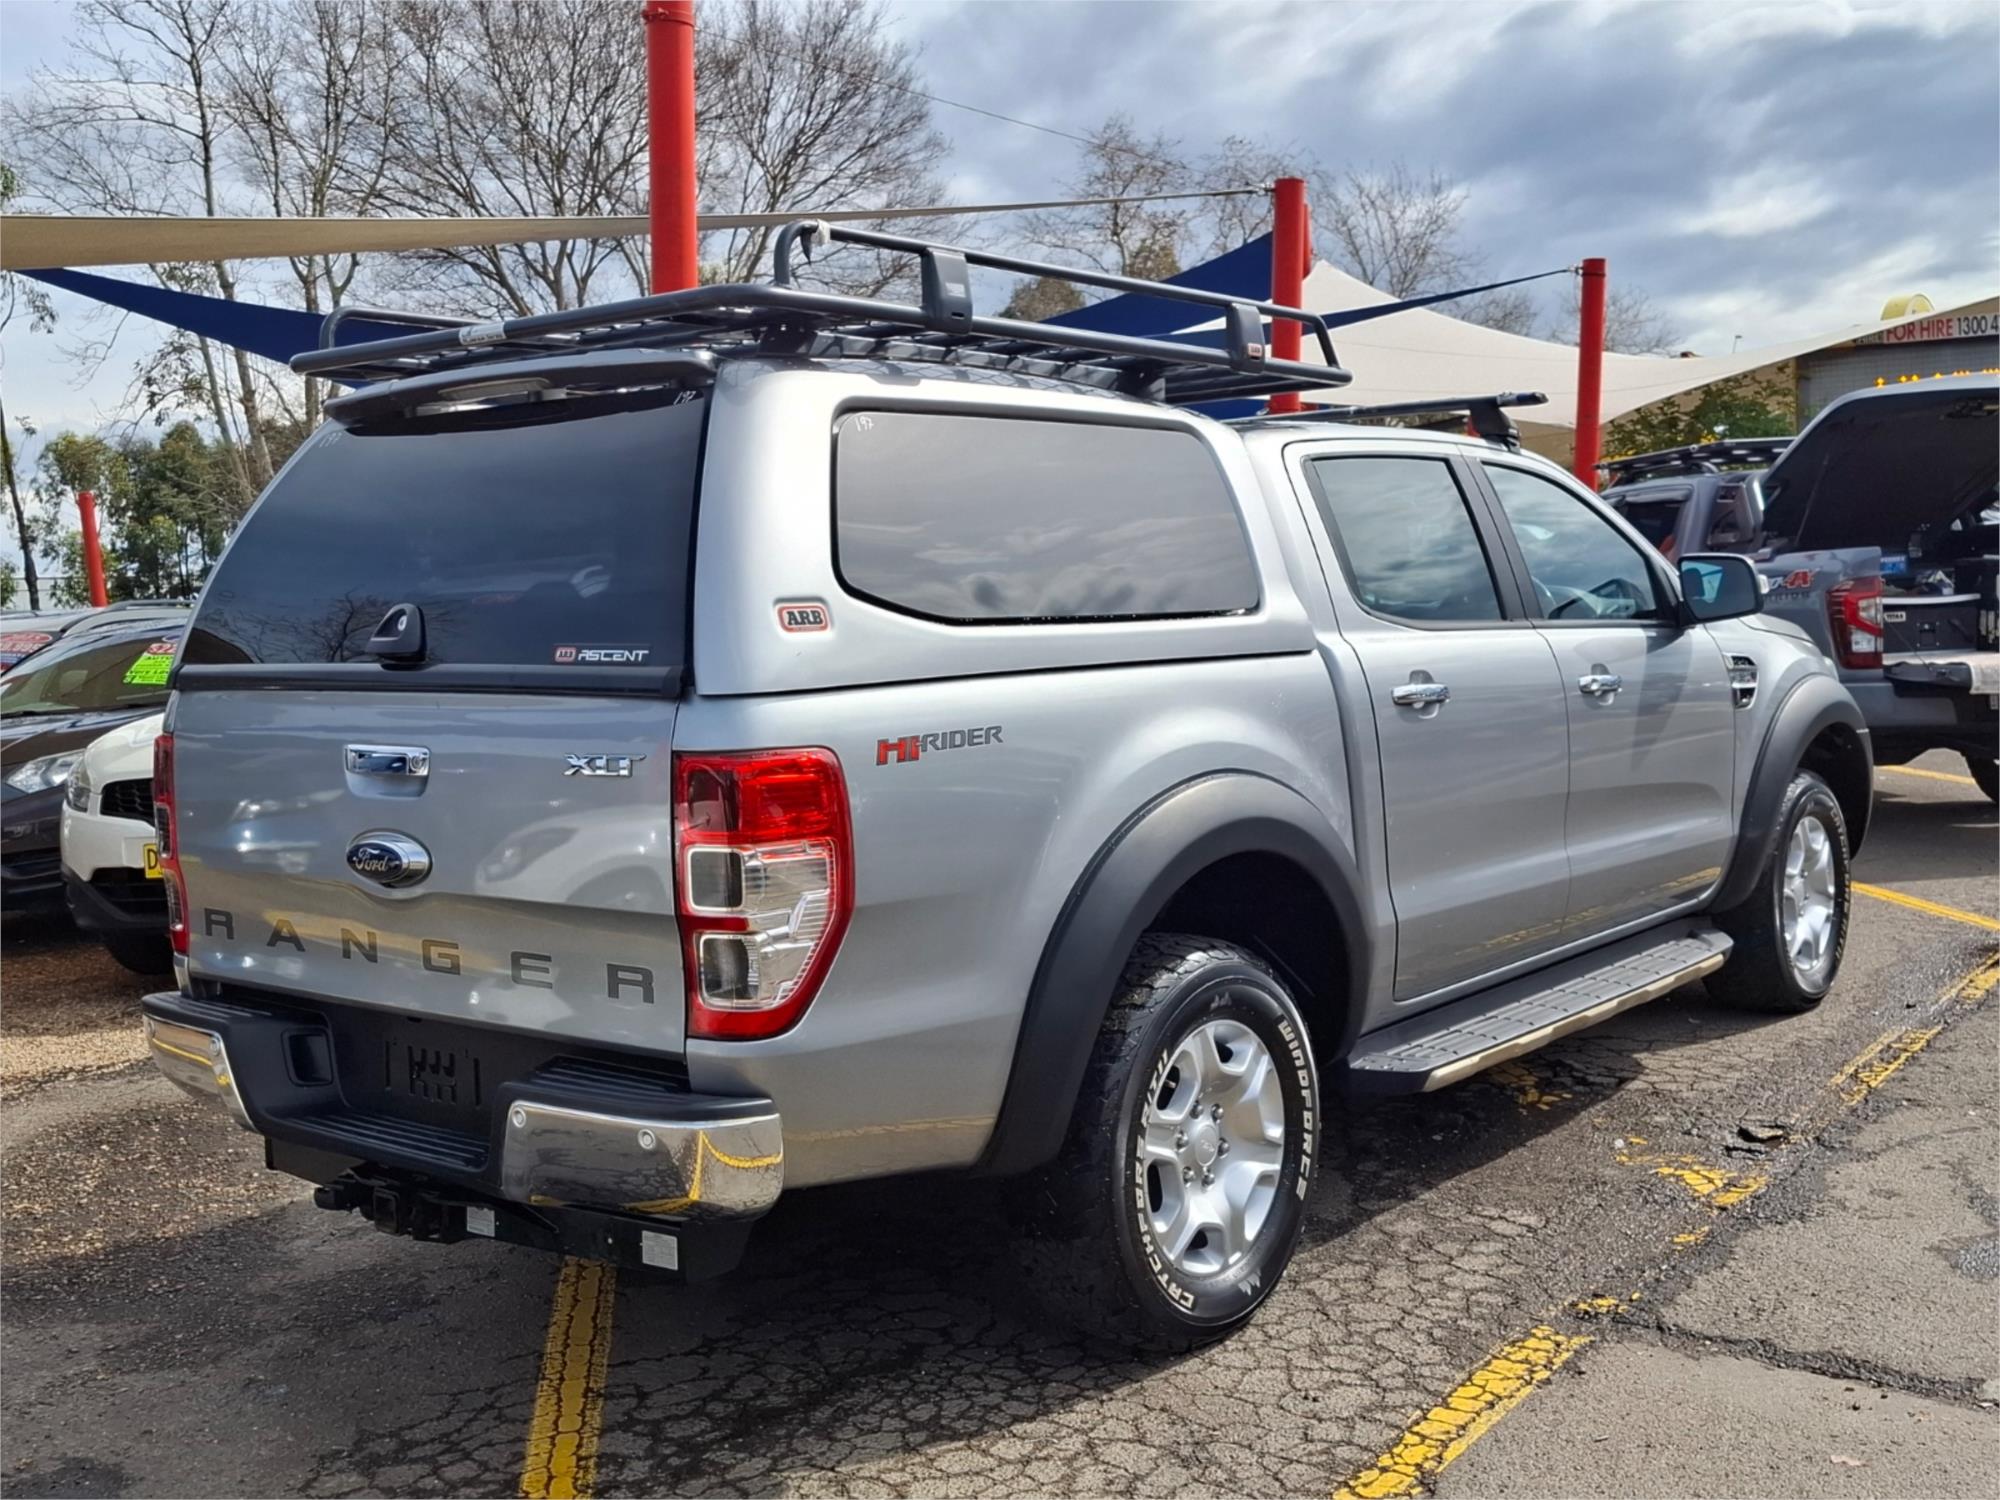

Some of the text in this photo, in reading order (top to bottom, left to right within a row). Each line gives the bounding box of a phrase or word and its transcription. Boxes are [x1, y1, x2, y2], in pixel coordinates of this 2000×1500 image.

[1886, 322, 1917, 342] FOR
[1920, 318, 1954, 338] HIRE
[1957, 315, 1988, 336] 1300
[787, 610, 823, 626] ARB
[578, 650, 649, 661] ASCENT
[563, 754, 646, 777] XLT
[352, 847, 400, 872] Ford
[203, 907, 655, 1004] RANGER
